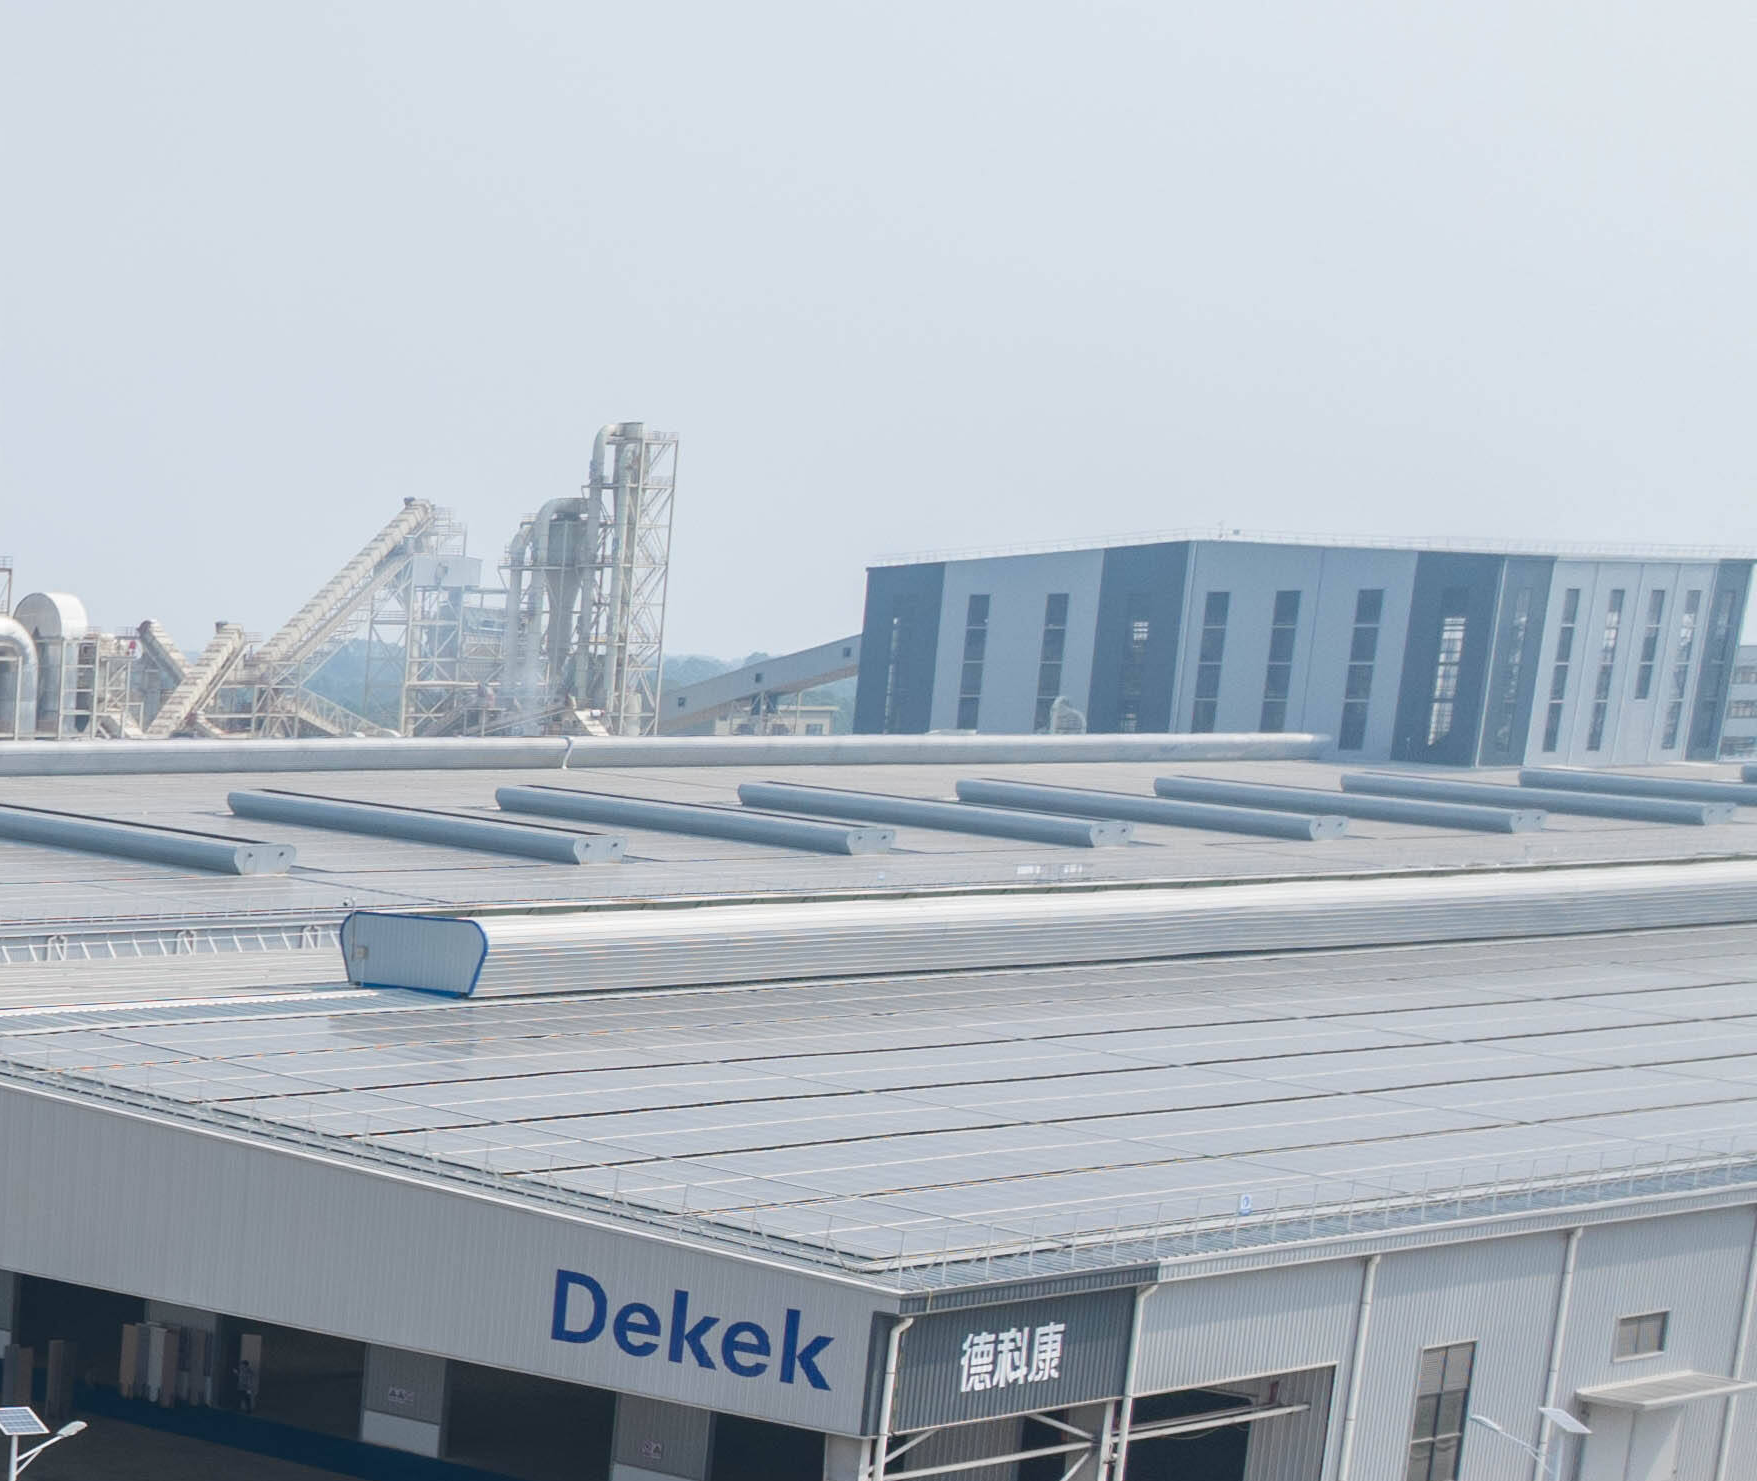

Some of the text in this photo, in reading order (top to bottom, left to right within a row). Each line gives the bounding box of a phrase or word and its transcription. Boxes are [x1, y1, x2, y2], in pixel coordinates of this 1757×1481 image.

[550, 1268, 835, 1391] Dekek
[960, 1321, 1066, 1393] 德科康
